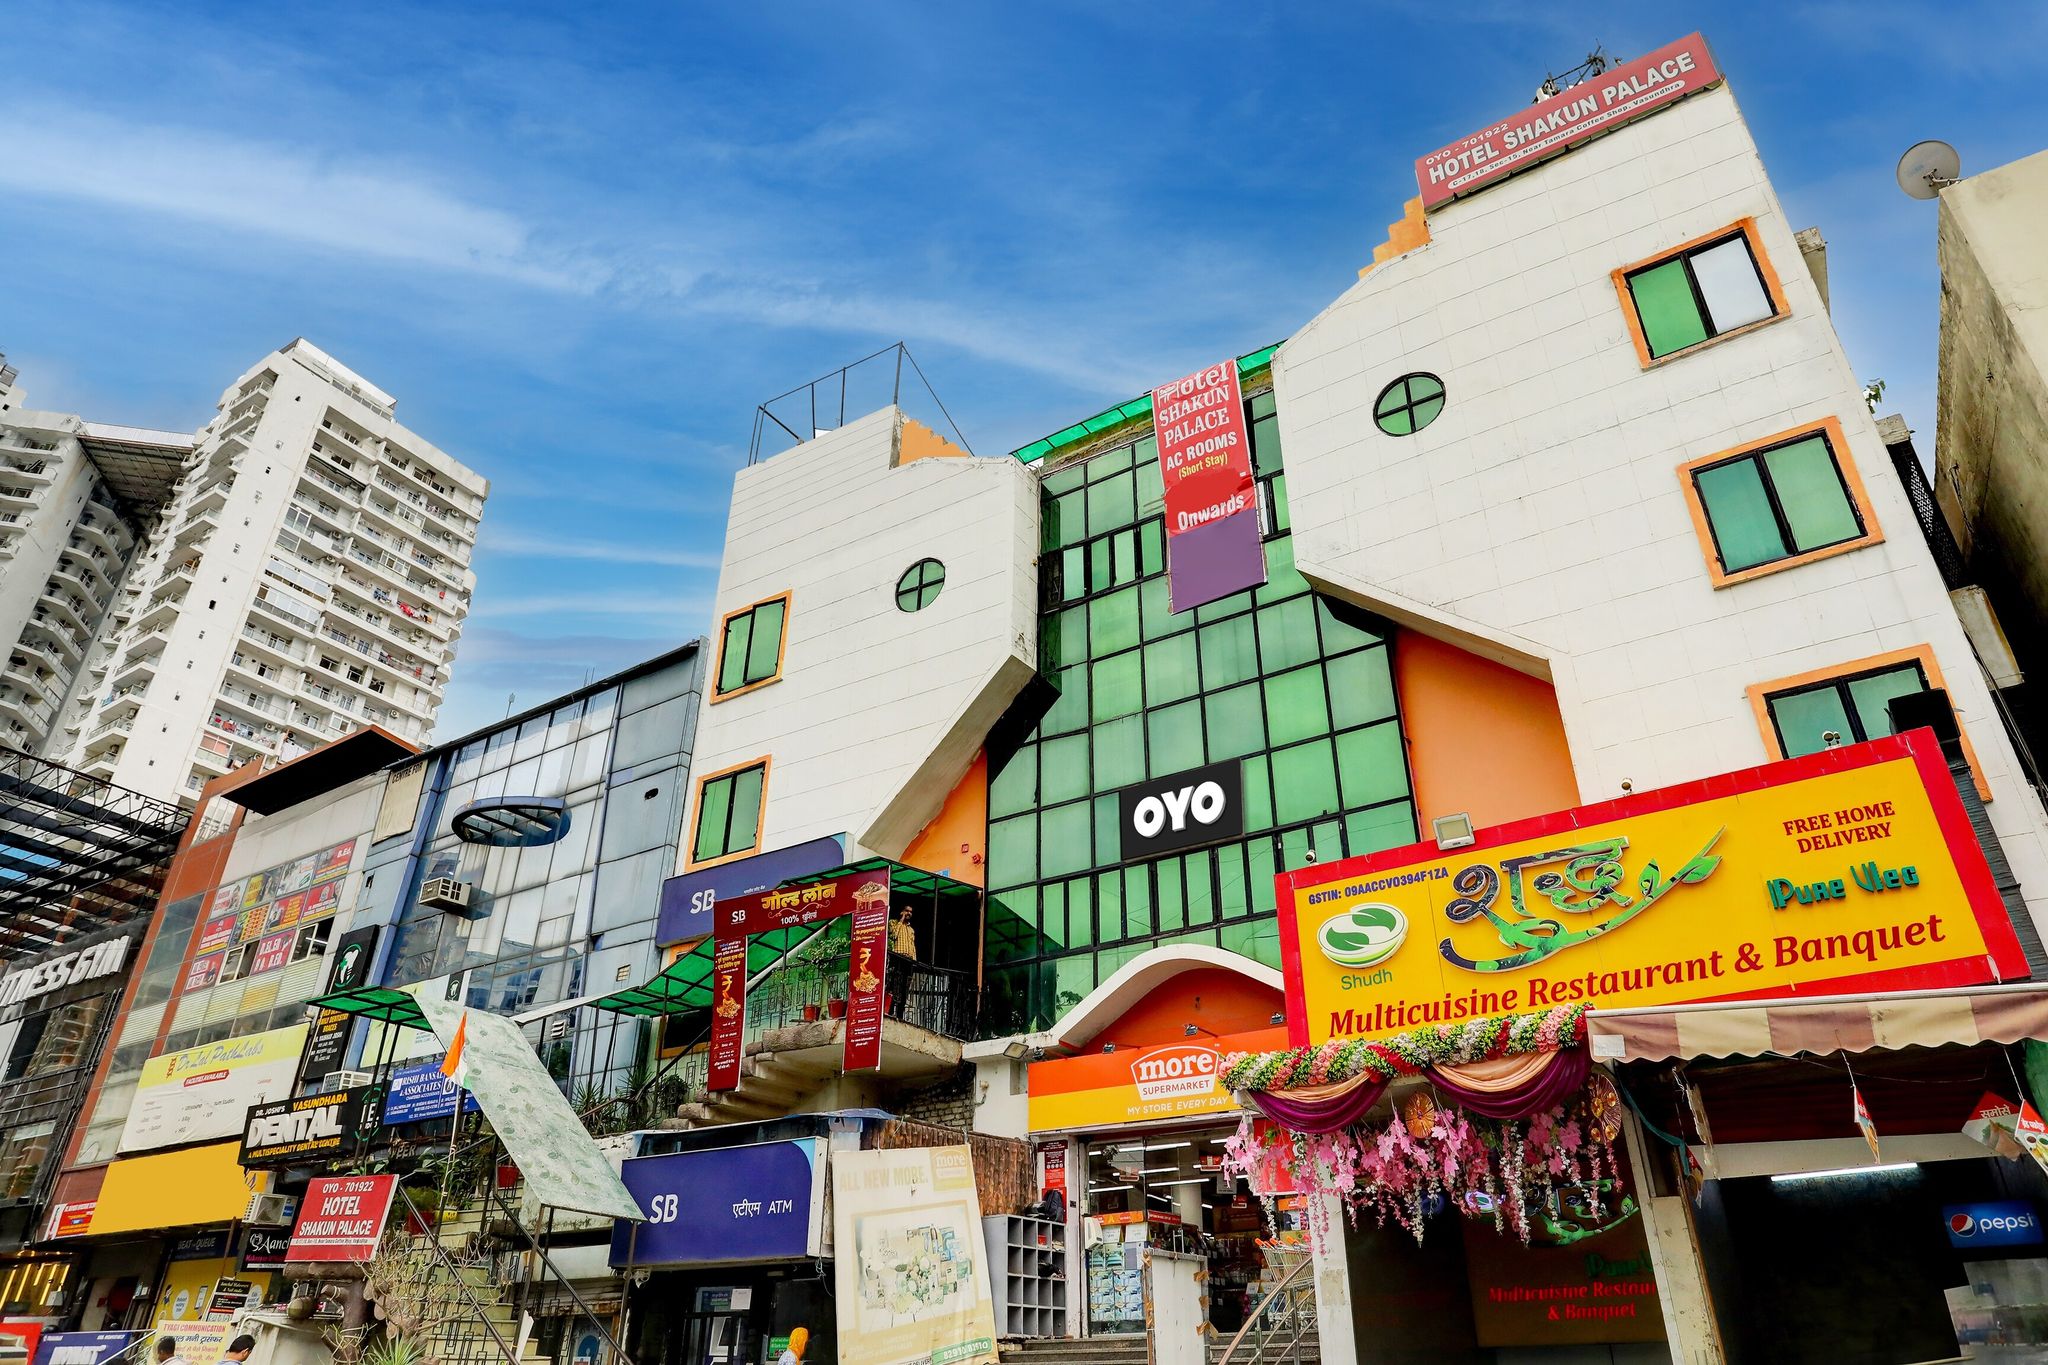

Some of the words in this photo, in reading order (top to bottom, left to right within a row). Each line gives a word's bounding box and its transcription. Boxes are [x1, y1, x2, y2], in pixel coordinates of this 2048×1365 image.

[1429, 141, 1499, 184] HOTEL
[1504, 94, 1598, 150] SHAKUN
[1602, 52, 1696, 105] PALACE
[1523, 143, 1541, 155] Near
[1544, 128, 1574, 146] Tamara
[1576, 115, 1605, 131] Coffee
[1633, 82, 1681, 106] Vasundhra
[1425, 149, 1450, 166] OYO
[1462, 123, 1509, 147] 701922
[1159, 385, 1230, 427] SHAKUN
[1164, 407, 1230, 448] PALACE
[1166, 452, 1183, 471] AC
[1187, 431, 1238, 463] ROOMS
[1178, 460, 1203, 481] (Short
[1205, 451, 1229, 470] Stay)
[1177, 494, 1246, 531] Onwards
[1133, 781, 1226, 838] OYO
[1783, 813, 1833, 836] FREE
[1834, 800, 1896, 827] HOME
[1796, 821, 1892, 853] DELIVERY
[761, 886, 803, 912] गोल्ड
[803, 882, 838, 904] लोन
[1308, 888, 1342, 905] GSTIN:
[731, 910, 746, 923] SB
[780, 914, 800, 926] 100%
[0, 951, 80, 1008] TNESS
[67, 935, 132, 985] GYM
[1328, 983, 1518, 1038] Multicuisine
[1528, 950, 1725, 1009] Restaurant
[1734, 941, 1765, 972] &
[1772, 914, 1946, 969] Banquet
[1340, 968, 1393, 991] Shudh
[1139, 1052, 1214, 1081] more
[292, 1093, 348, 1112] VASUNDHARA
[1142, 1080, 1210, 1096] SUPERMARKET
[1127, 1106, 1141, 1116] MY
[1143, 1102, 1173, 1115] STORE
[1176, 1098, 1206, 1111] EVERY
[1209, 1095, 1229, 1107] DAY
[246, 1105, 343, 1149] DENTAL
[935, 1153, 967, 1168] more
[322, 1183, 339, 1194] OYO
[344, 1181, 374, 1193] 701922
[839, 1172, 860, 1193] ALL
[863, 1168, 890, 1190] NEW
[320, 1196, 360, 1216] HOTEL
[649, 1193, 679, 1225] SB
[732, 1198, 762, 1219] एटीएम
[768, 1199, 793, 1215] ATM
[299, 1220, 336, 1236] SHAKUN
[336, 1220, 373, 1236] PALACE
[1979, 1212, 2034, 1234] pepsi
[1565, 1300, 1637, 1323] Banquet
